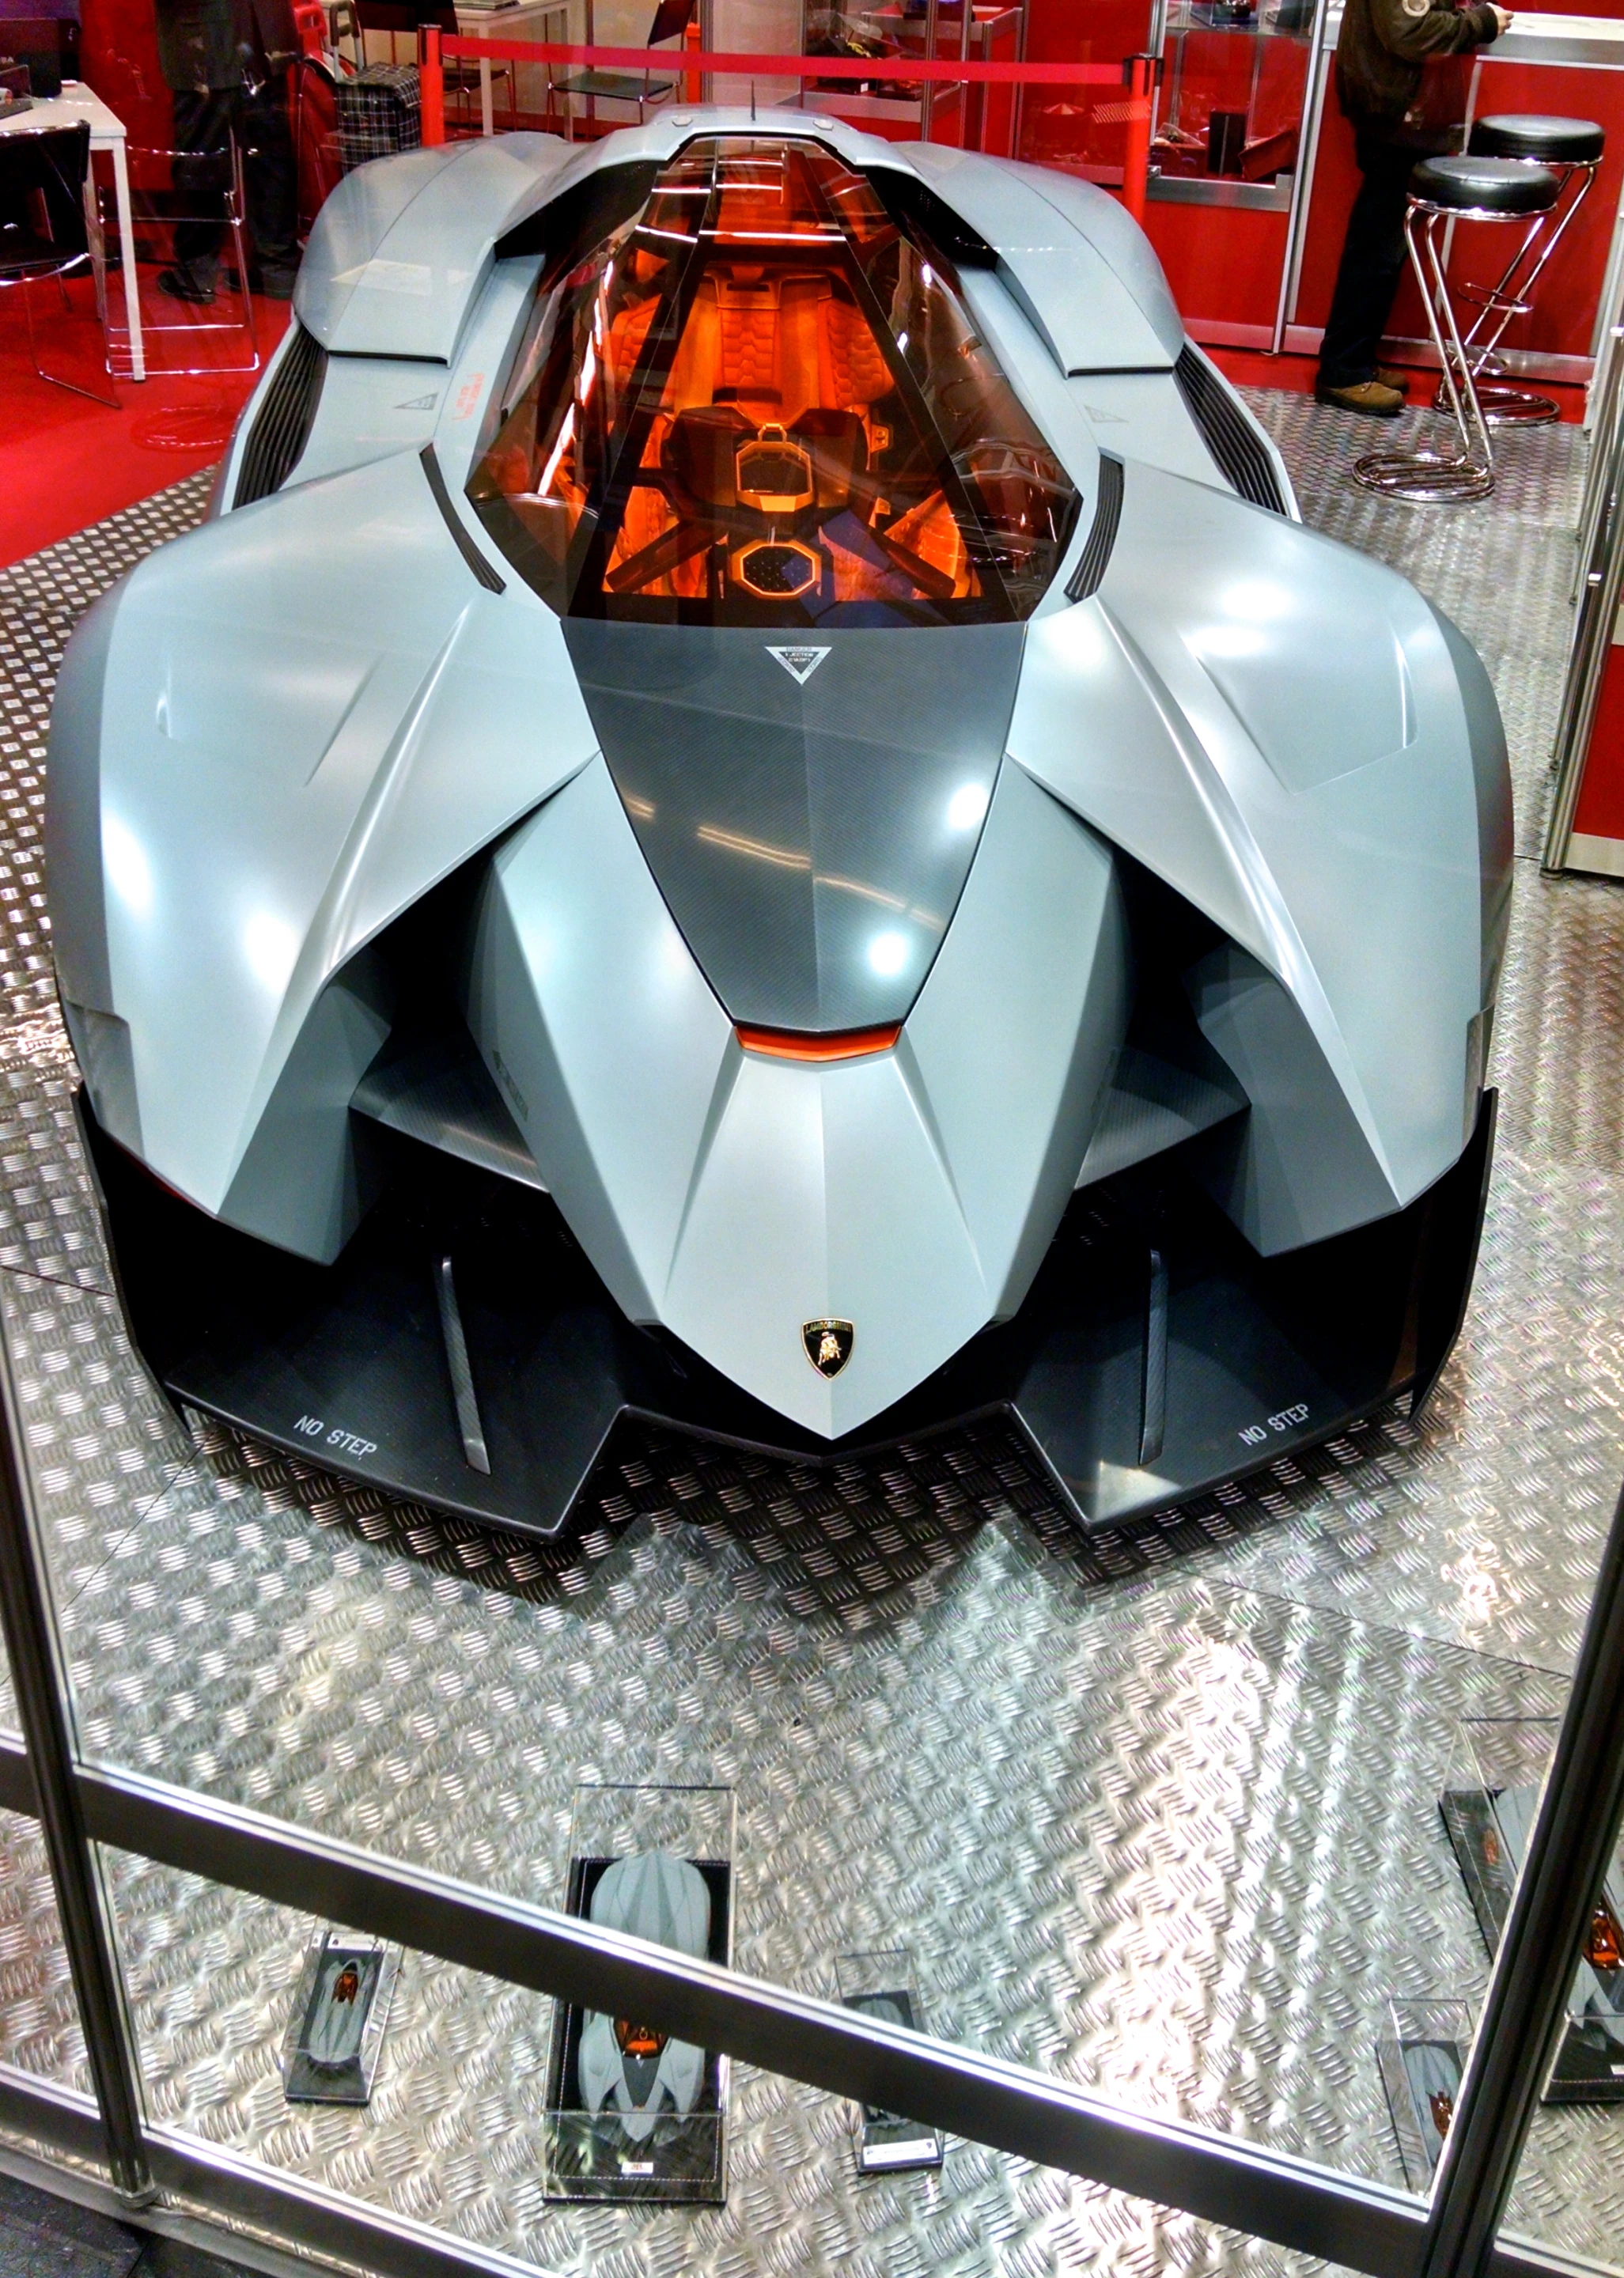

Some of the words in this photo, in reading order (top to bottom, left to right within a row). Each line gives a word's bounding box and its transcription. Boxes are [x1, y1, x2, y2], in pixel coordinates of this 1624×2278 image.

[293, 1415, 324, 1436] NO
[327, 1429, 377, 1456] STEP
[1238, 1425, 1267, 1446] NO
[1267, 1403, 1309, 1431] STEP
